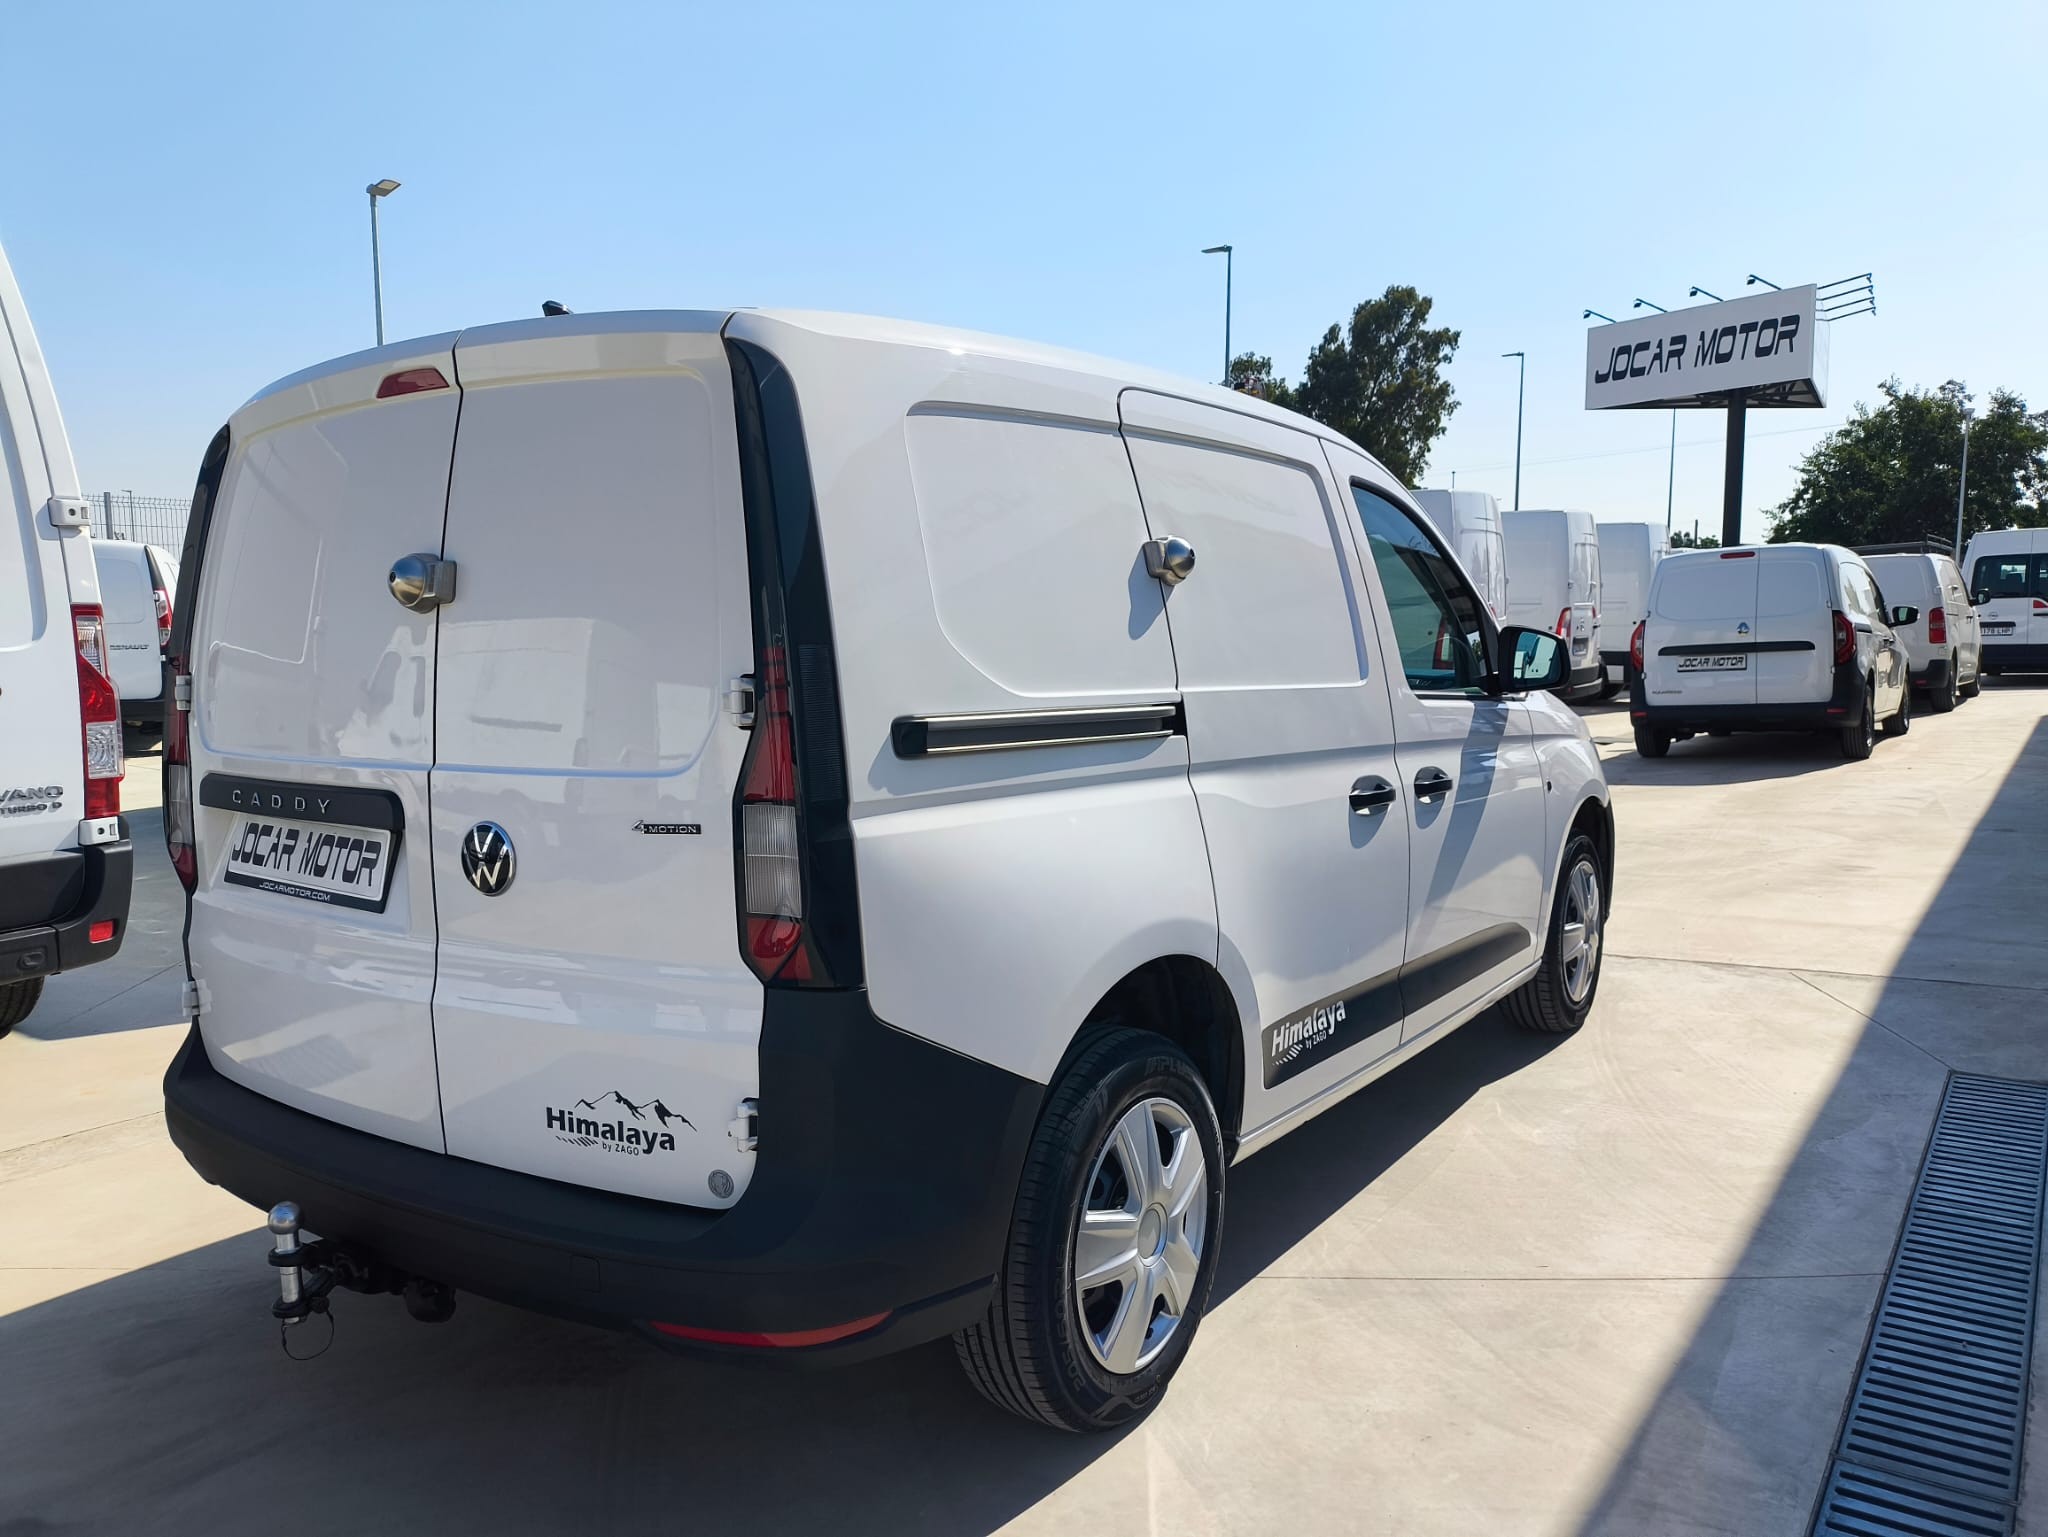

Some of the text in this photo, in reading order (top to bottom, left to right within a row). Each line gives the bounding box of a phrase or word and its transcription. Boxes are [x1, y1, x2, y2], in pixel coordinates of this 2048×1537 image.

[1594, 314, 1800, 384] JOCAR MOTOR
[1678, 656, 1744, 668] JOCAR MOTOR
[231, 788, 332, 816] CADDY
[232, 822, 382, 887] JOCAR MOTOR
[258, 881, 332, 903] JOCARMOTOR.COM
[1271, 1000, 1346, 1057] Himalaya
[1313, 1030, 1327, 1045] ZAGO
[546, 1107, 675, 1154] Himalaya
[602, 1141, 640, 1156] by ZAGO
